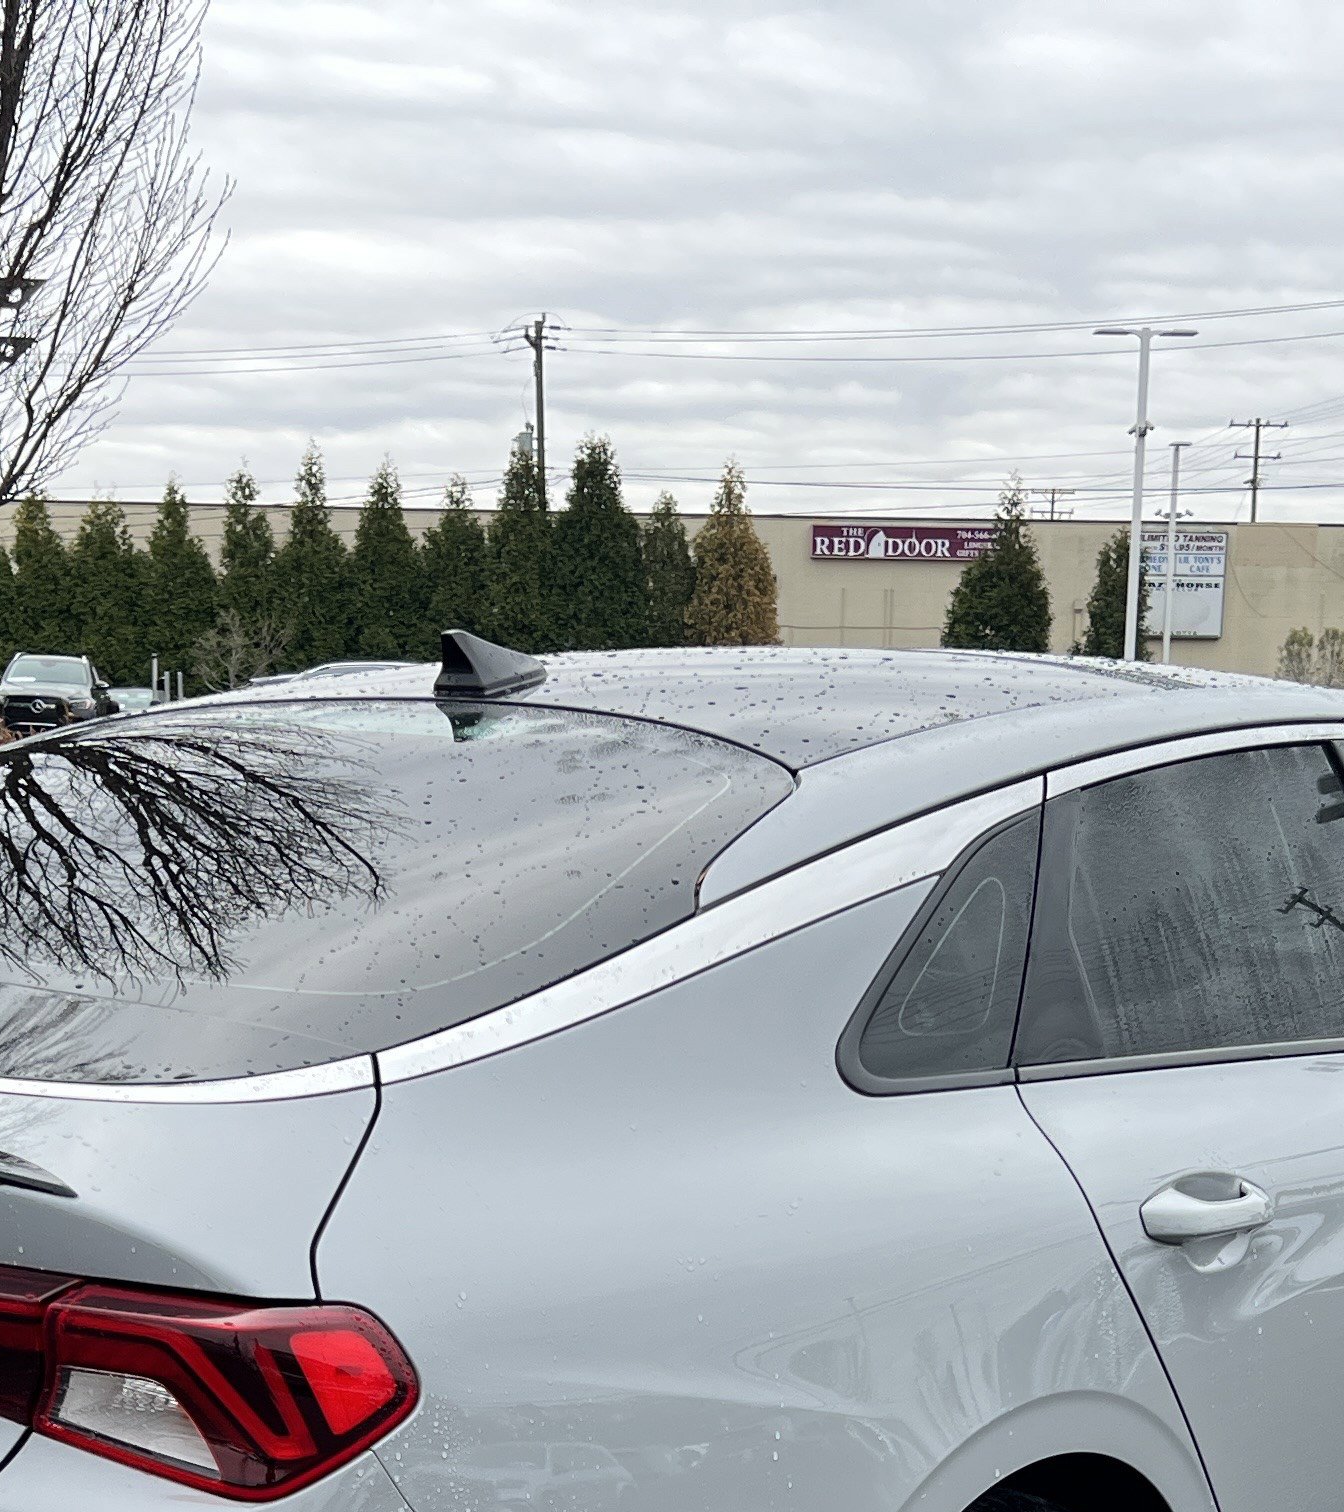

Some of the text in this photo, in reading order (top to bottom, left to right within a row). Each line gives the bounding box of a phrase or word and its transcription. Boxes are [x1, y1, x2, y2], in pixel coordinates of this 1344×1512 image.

[841, 527, 865, 536] THE
[1183, 534, 1224, 543] TANNING
[814, 537, 951, 557] RED DOOR
